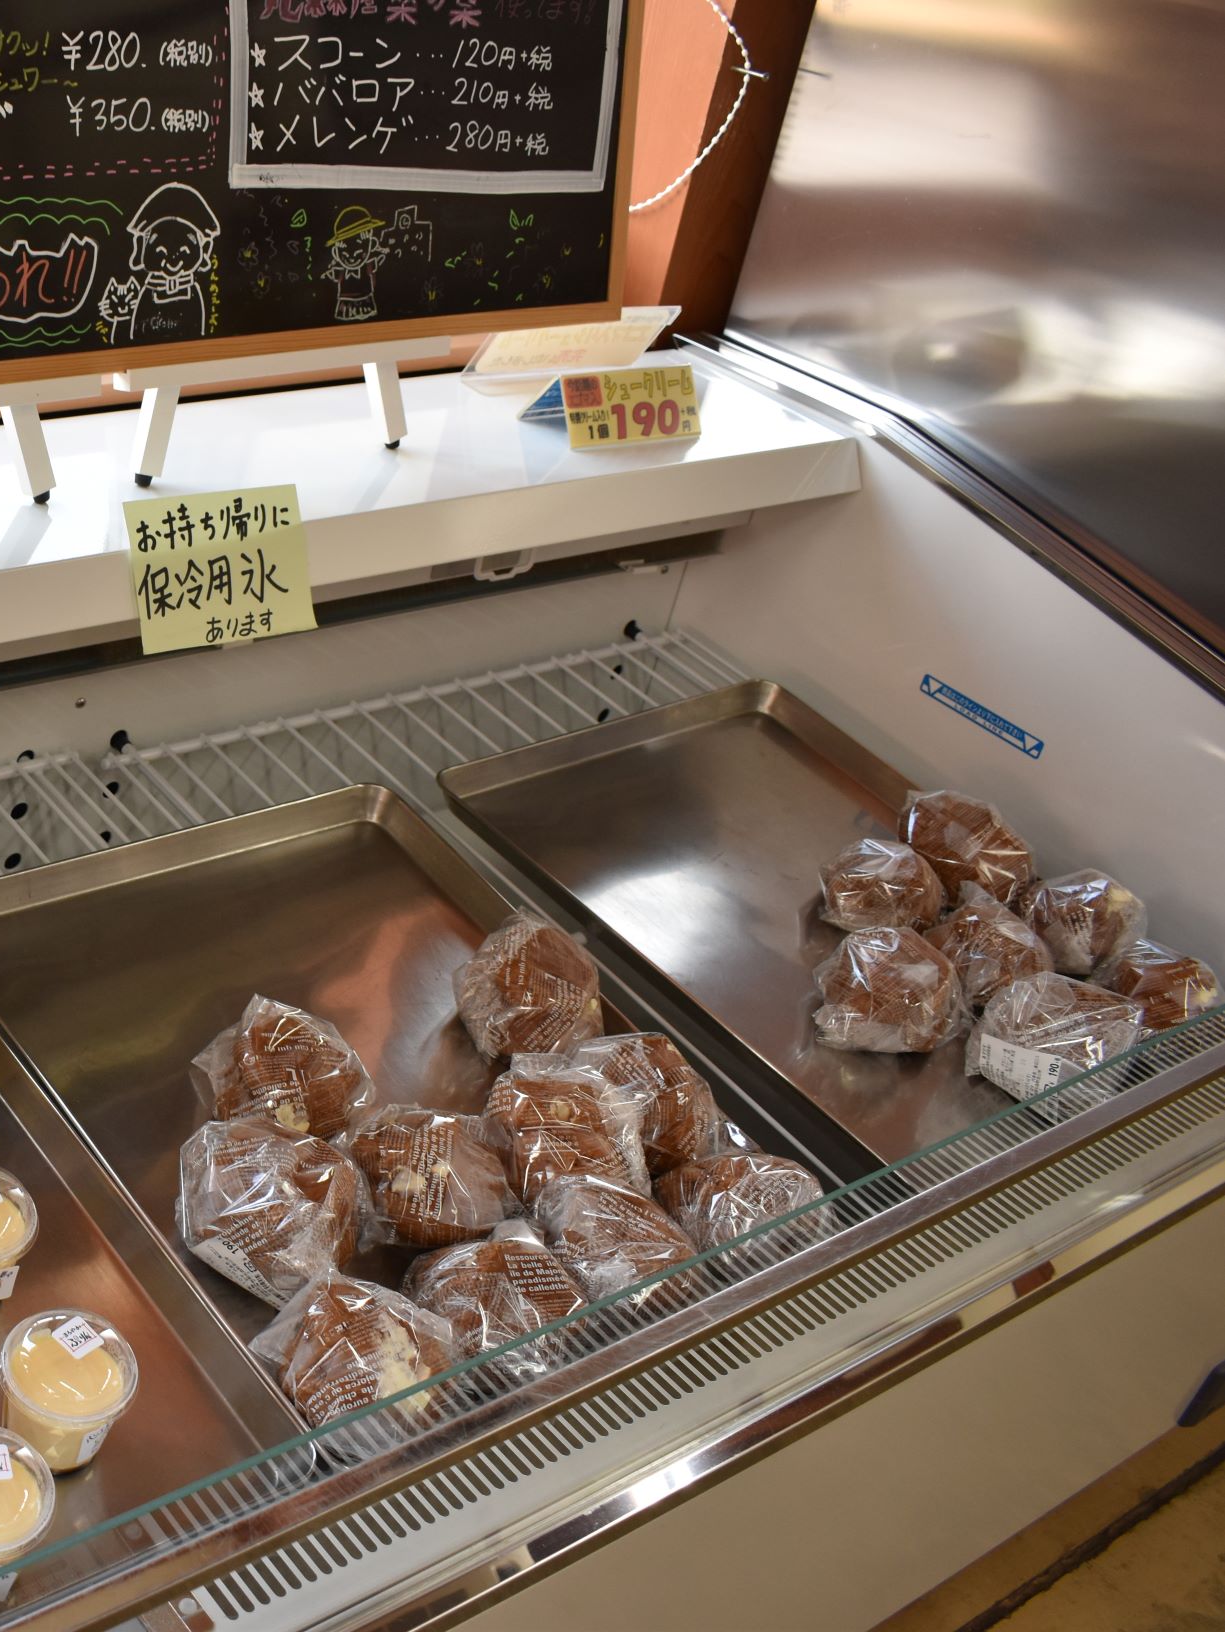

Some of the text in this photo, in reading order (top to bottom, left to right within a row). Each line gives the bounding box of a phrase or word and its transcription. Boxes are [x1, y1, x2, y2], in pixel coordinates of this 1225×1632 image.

[274, 35, 401, 71] スコーン
[274, 75, 415, 112] ババロア
[276, 115, 414, 154] メレンゲ
[611, 399, 680, 440] 190
[136, 497, 290, 553] お持ち帰りに
[138, 548, 289, 620] 保冷用氷
[205, 608, 273, 643] あります
